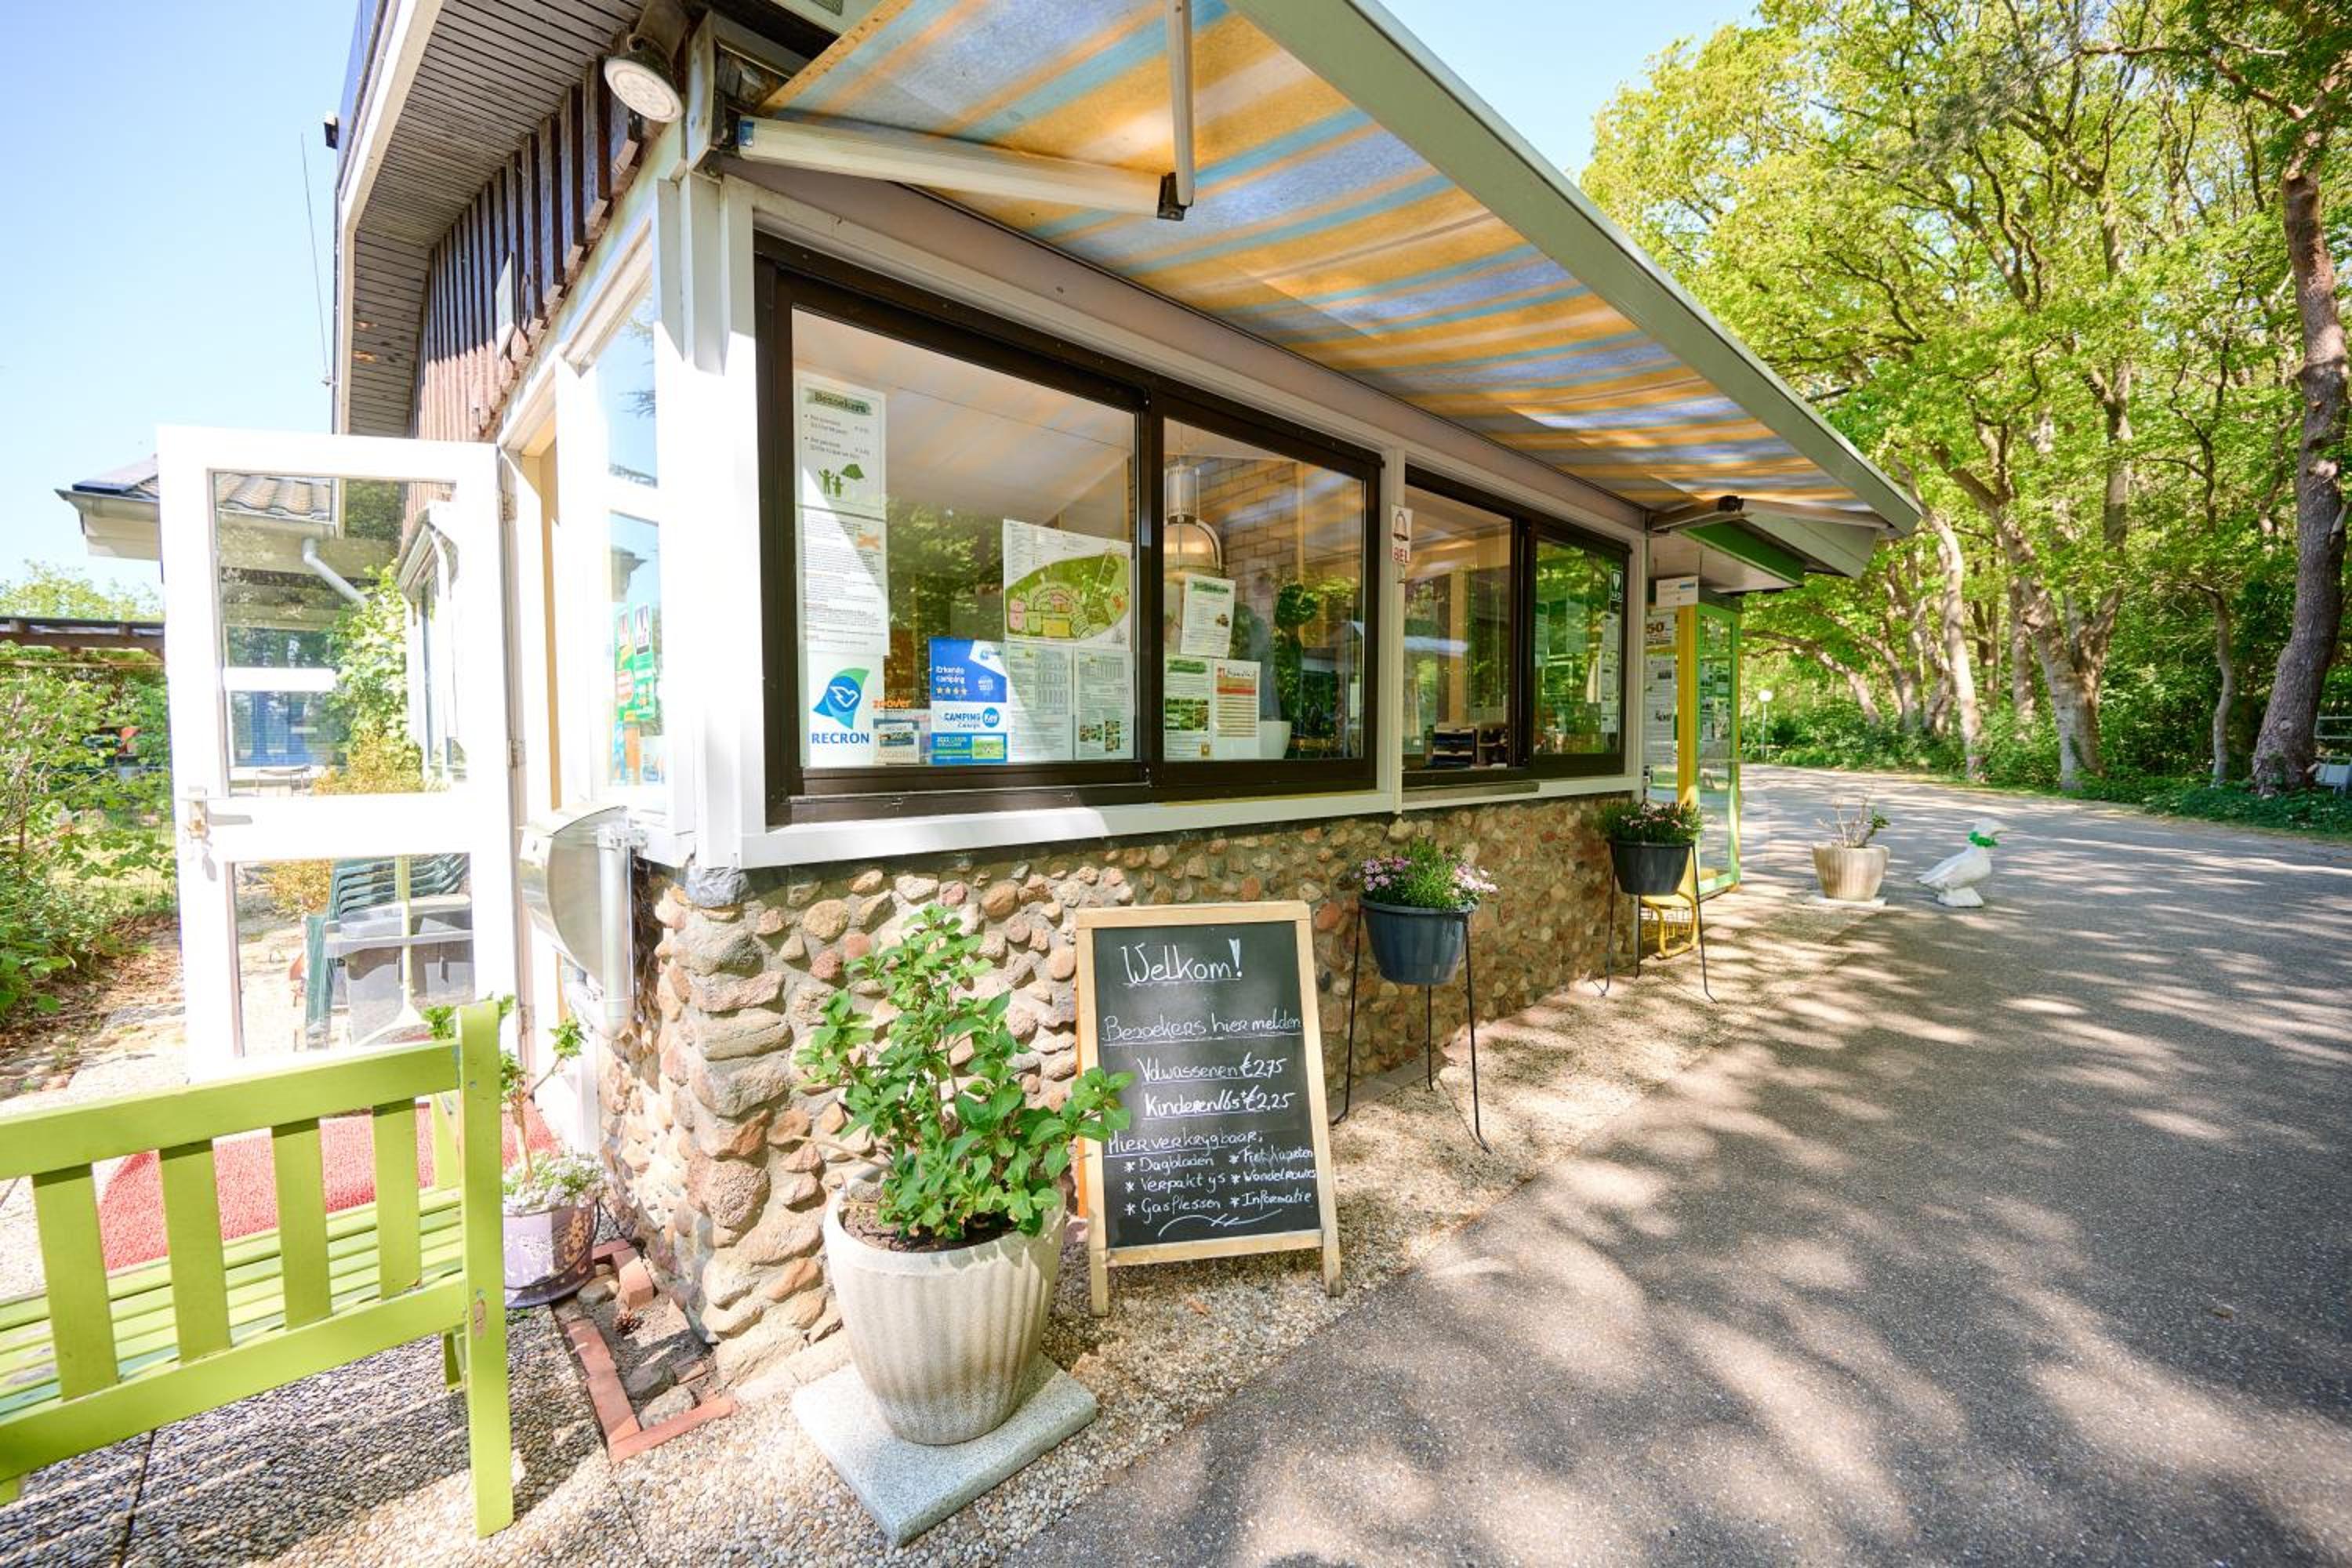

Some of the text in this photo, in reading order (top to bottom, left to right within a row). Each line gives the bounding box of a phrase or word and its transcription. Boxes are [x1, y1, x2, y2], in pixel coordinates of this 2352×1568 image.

[815, 391, 866, 414] Bezoekers
[1393, 546, 1411, 564] BEL
[1646, 622, 1664, 634] 50
[944, 712, 981, 721] CAMPING
[811, 731, 869, 744] RECRON
[1121, 938, 1243, 984] Welkom!
[1102, 1007, 1301, 1042] Bezoekers hier melden
[1137, 1058, 1238, 1083] Volwassenen
[1108, 1130, 1147, 1154] Hier
[1139, 1156, 1214, 1175] Dagbladen
[1142, 1173, 1203, 1193] Verpakt
[1241, 1187, 1312, 1210] Informatie
